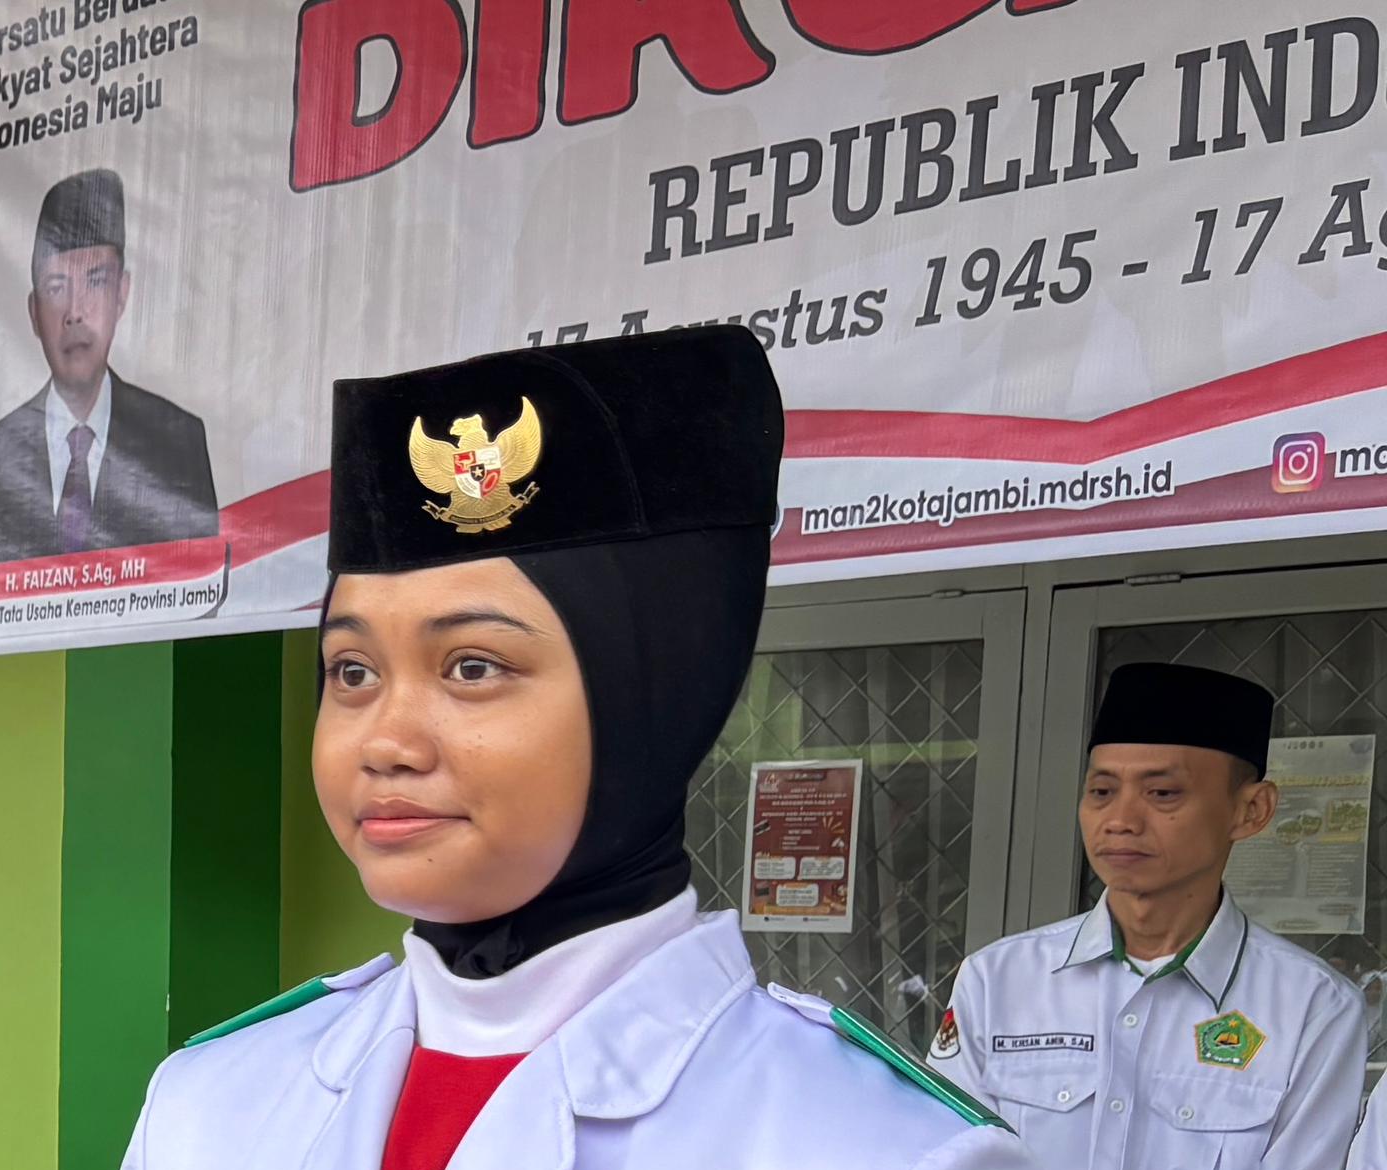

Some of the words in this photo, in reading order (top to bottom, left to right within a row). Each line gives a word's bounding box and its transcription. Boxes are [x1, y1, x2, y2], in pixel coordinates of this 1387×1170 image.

[73, 0, 167, 30] Ber
[59, 15, 199, 85] Sejahtera
[96, 72, 162, 124] Maju
[644, 62, 1145, 265] REPUBLIK
[1170, 17, 1387, 161] IND
[914, 229, 1097, 327] 1945
[1180, 197, 1284, 285] 17
[1298, 178, 1387, 271] A
[804, 460, 1172, 531] man2kotajambi.mdrsh.id
[0, 605, 24, 624] Tata
[26, 601, 63, 621] Usaha
[65, 595, 127, 618] Kemenag
[129, 589, 178, 611] Provinsi
[179, 584, 221, 607] Jambi
[5, 575, 19, 592] H.
[22, 567, 79, 592] FAIZAN,
[81, 566, 117, 587] S.Ag,
[120, 563, 146, 579] MH
